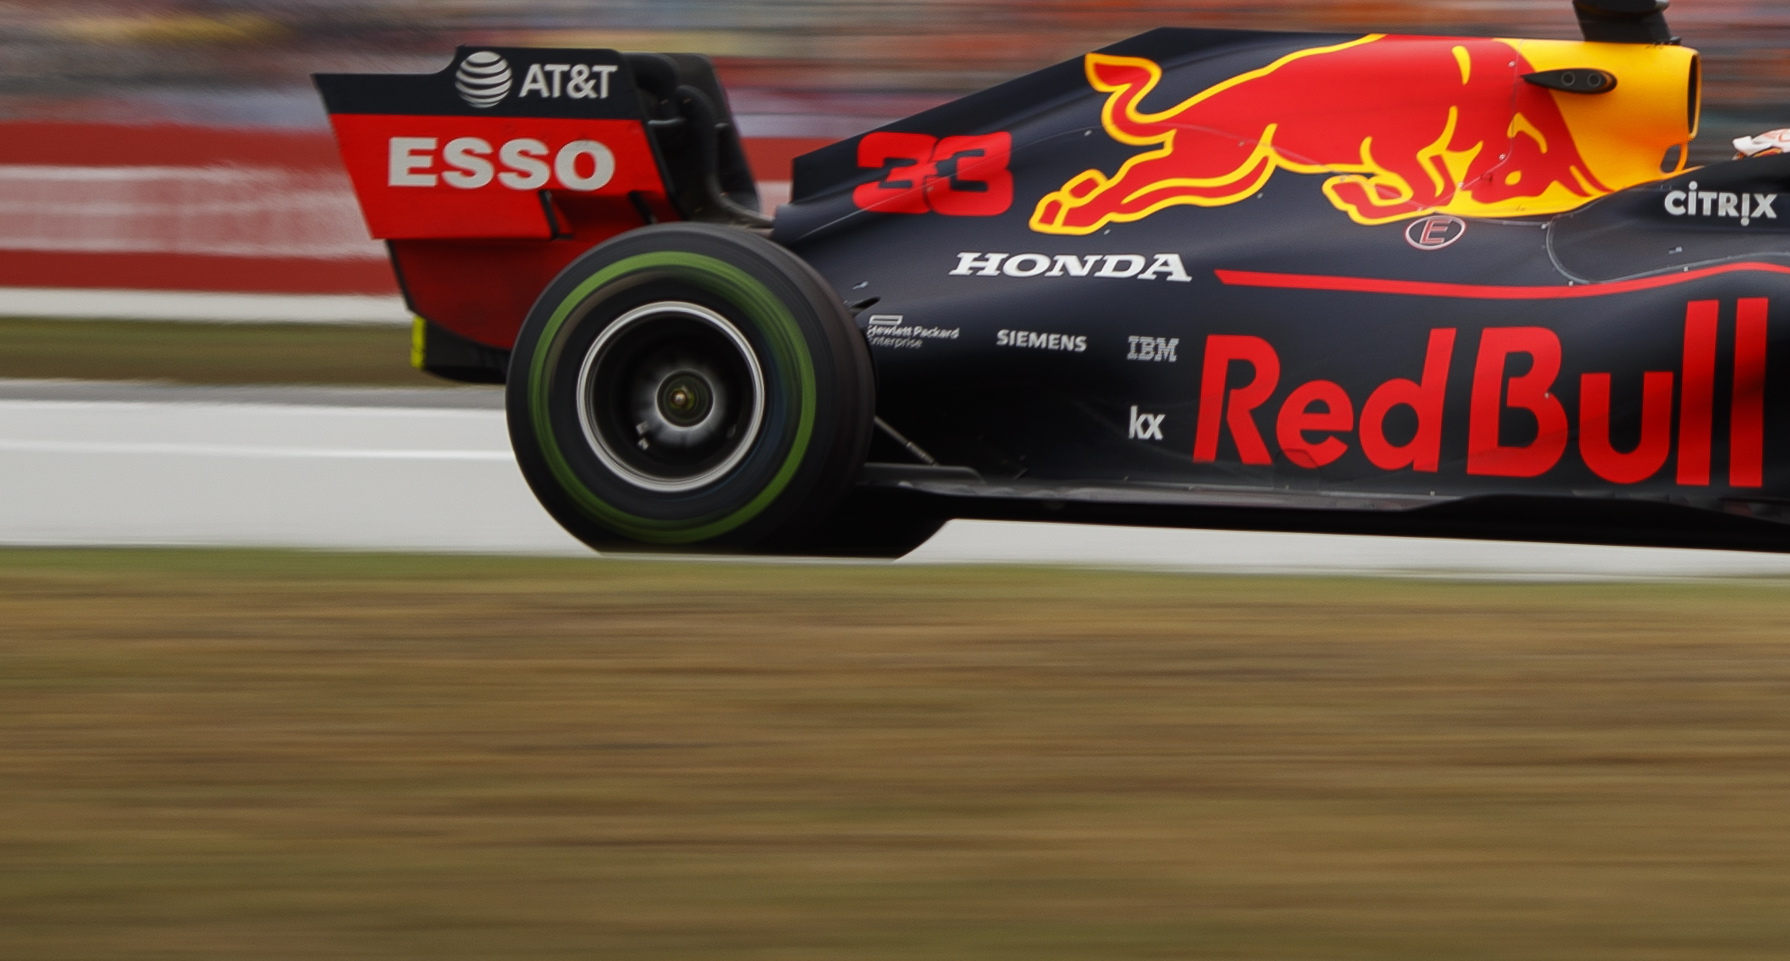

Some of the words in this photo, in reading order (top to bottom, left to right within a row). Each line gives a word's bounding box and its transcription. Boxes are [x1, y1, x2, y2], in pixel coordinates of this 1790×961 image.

[519, 64, 618, 99] AT&T
[388, 137, 615, 191] ESSO
[852, 131, 1014, 217] 33
[948, 252, 1193, 282] HONDA
[996, 329, 1087, 352] SIEMENS
[1126, 335, 1180, 362] IBM
